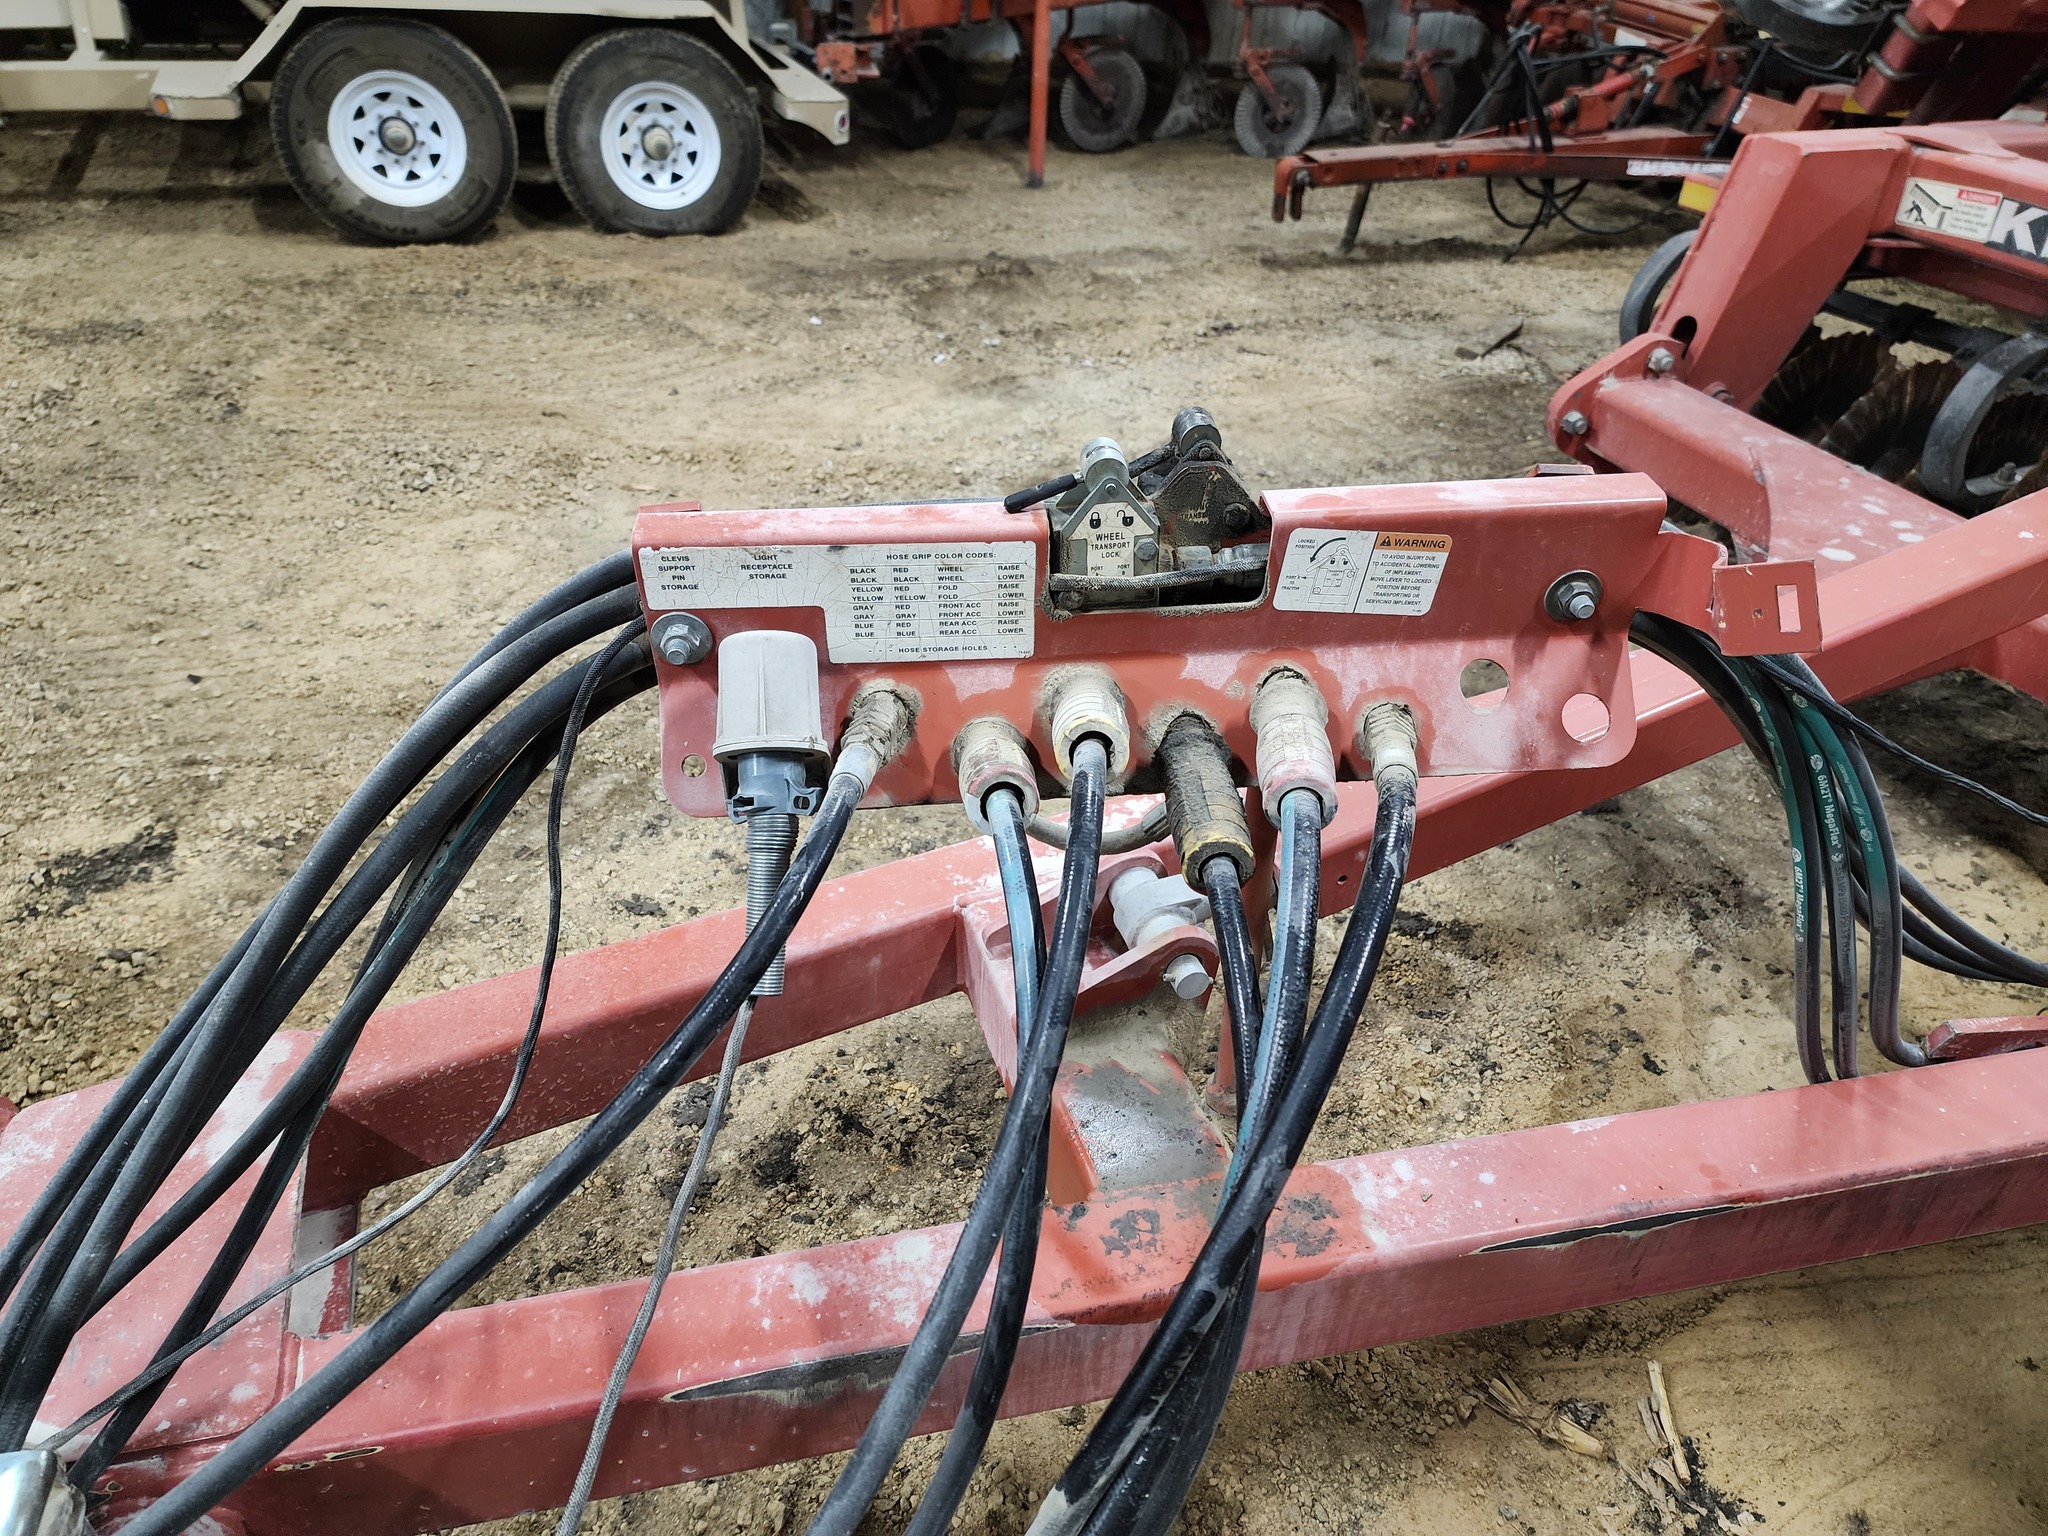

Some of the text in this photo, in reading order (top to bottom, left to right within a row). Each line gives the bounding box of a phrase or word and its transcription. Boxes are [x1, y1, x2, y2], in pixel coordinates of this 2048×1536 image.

[1992, 199, 2048, 258] K
[1096, 532, 1125, 541] WHEEL
[1091, 542, 1130, 550] TRANSPORT
[1394, 539, 1446, 548] WARNING
